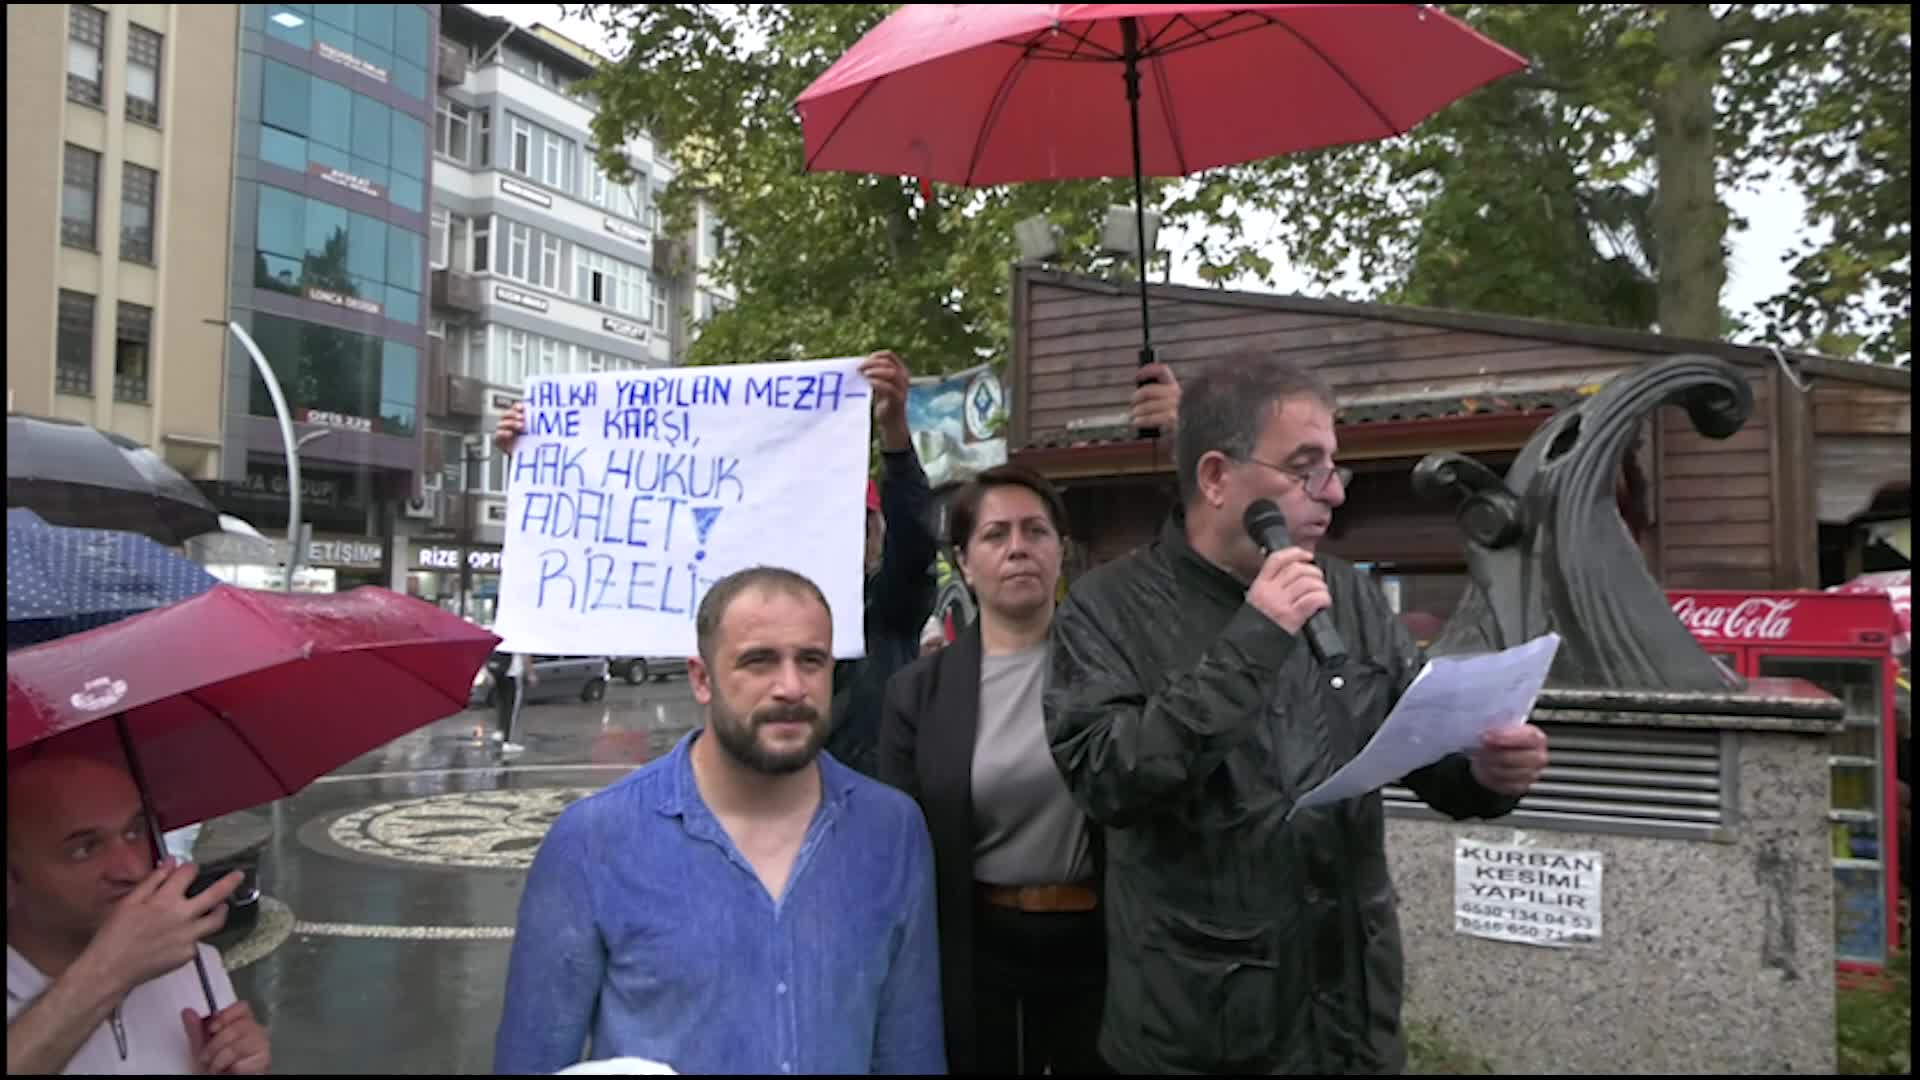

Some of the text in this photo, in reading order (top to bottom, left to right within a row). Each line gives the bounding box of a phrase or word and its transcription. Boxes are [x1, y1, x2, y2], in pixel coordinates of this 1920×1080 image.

[615, 375, 731, 407] YAPILAN
[514, 442, 744, 502] HAK HUKUK
[419, 546, 502, 568] RİZE OPT
[536, 547, 713, 621] RİZELİ
[1461, 847, 1594, 872] KURBAN
[1469, 882, 1587, 909] YAPILIR
